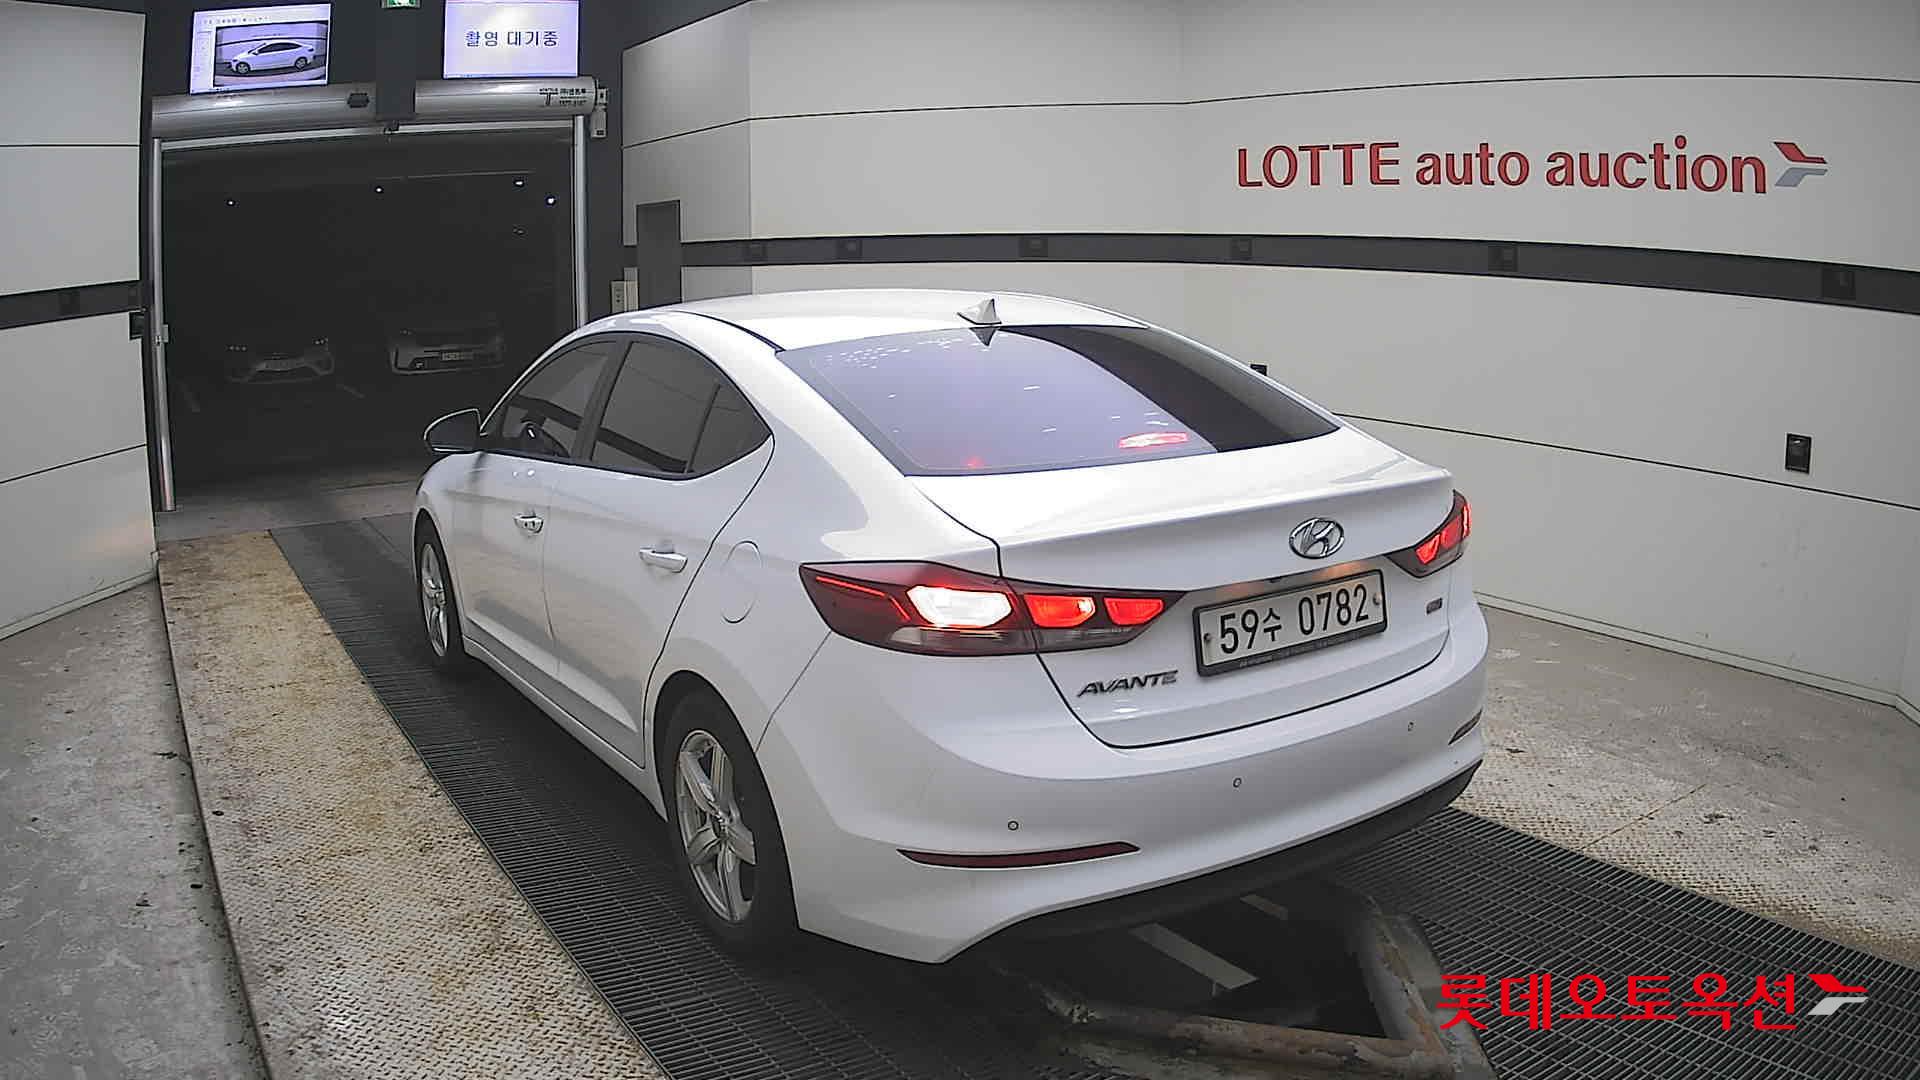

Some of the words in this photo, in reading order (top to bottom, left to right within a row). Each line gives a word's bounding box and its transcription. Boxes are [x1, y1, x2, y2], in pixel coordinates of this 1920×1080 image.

[465, 30, 498, 47] 촬영
[507, 30, 558, 47] 대기중
[1237, 142, 1400, 188] LOTTE
[1415, 142, 1530, 186] auto
[1545, 135, 1767, 194] auction
[1219, 608, 1283, 654] 59수
[1298, 583, 1369, 636] 0782
[1077, 669, 1179, 698] AVANTE
